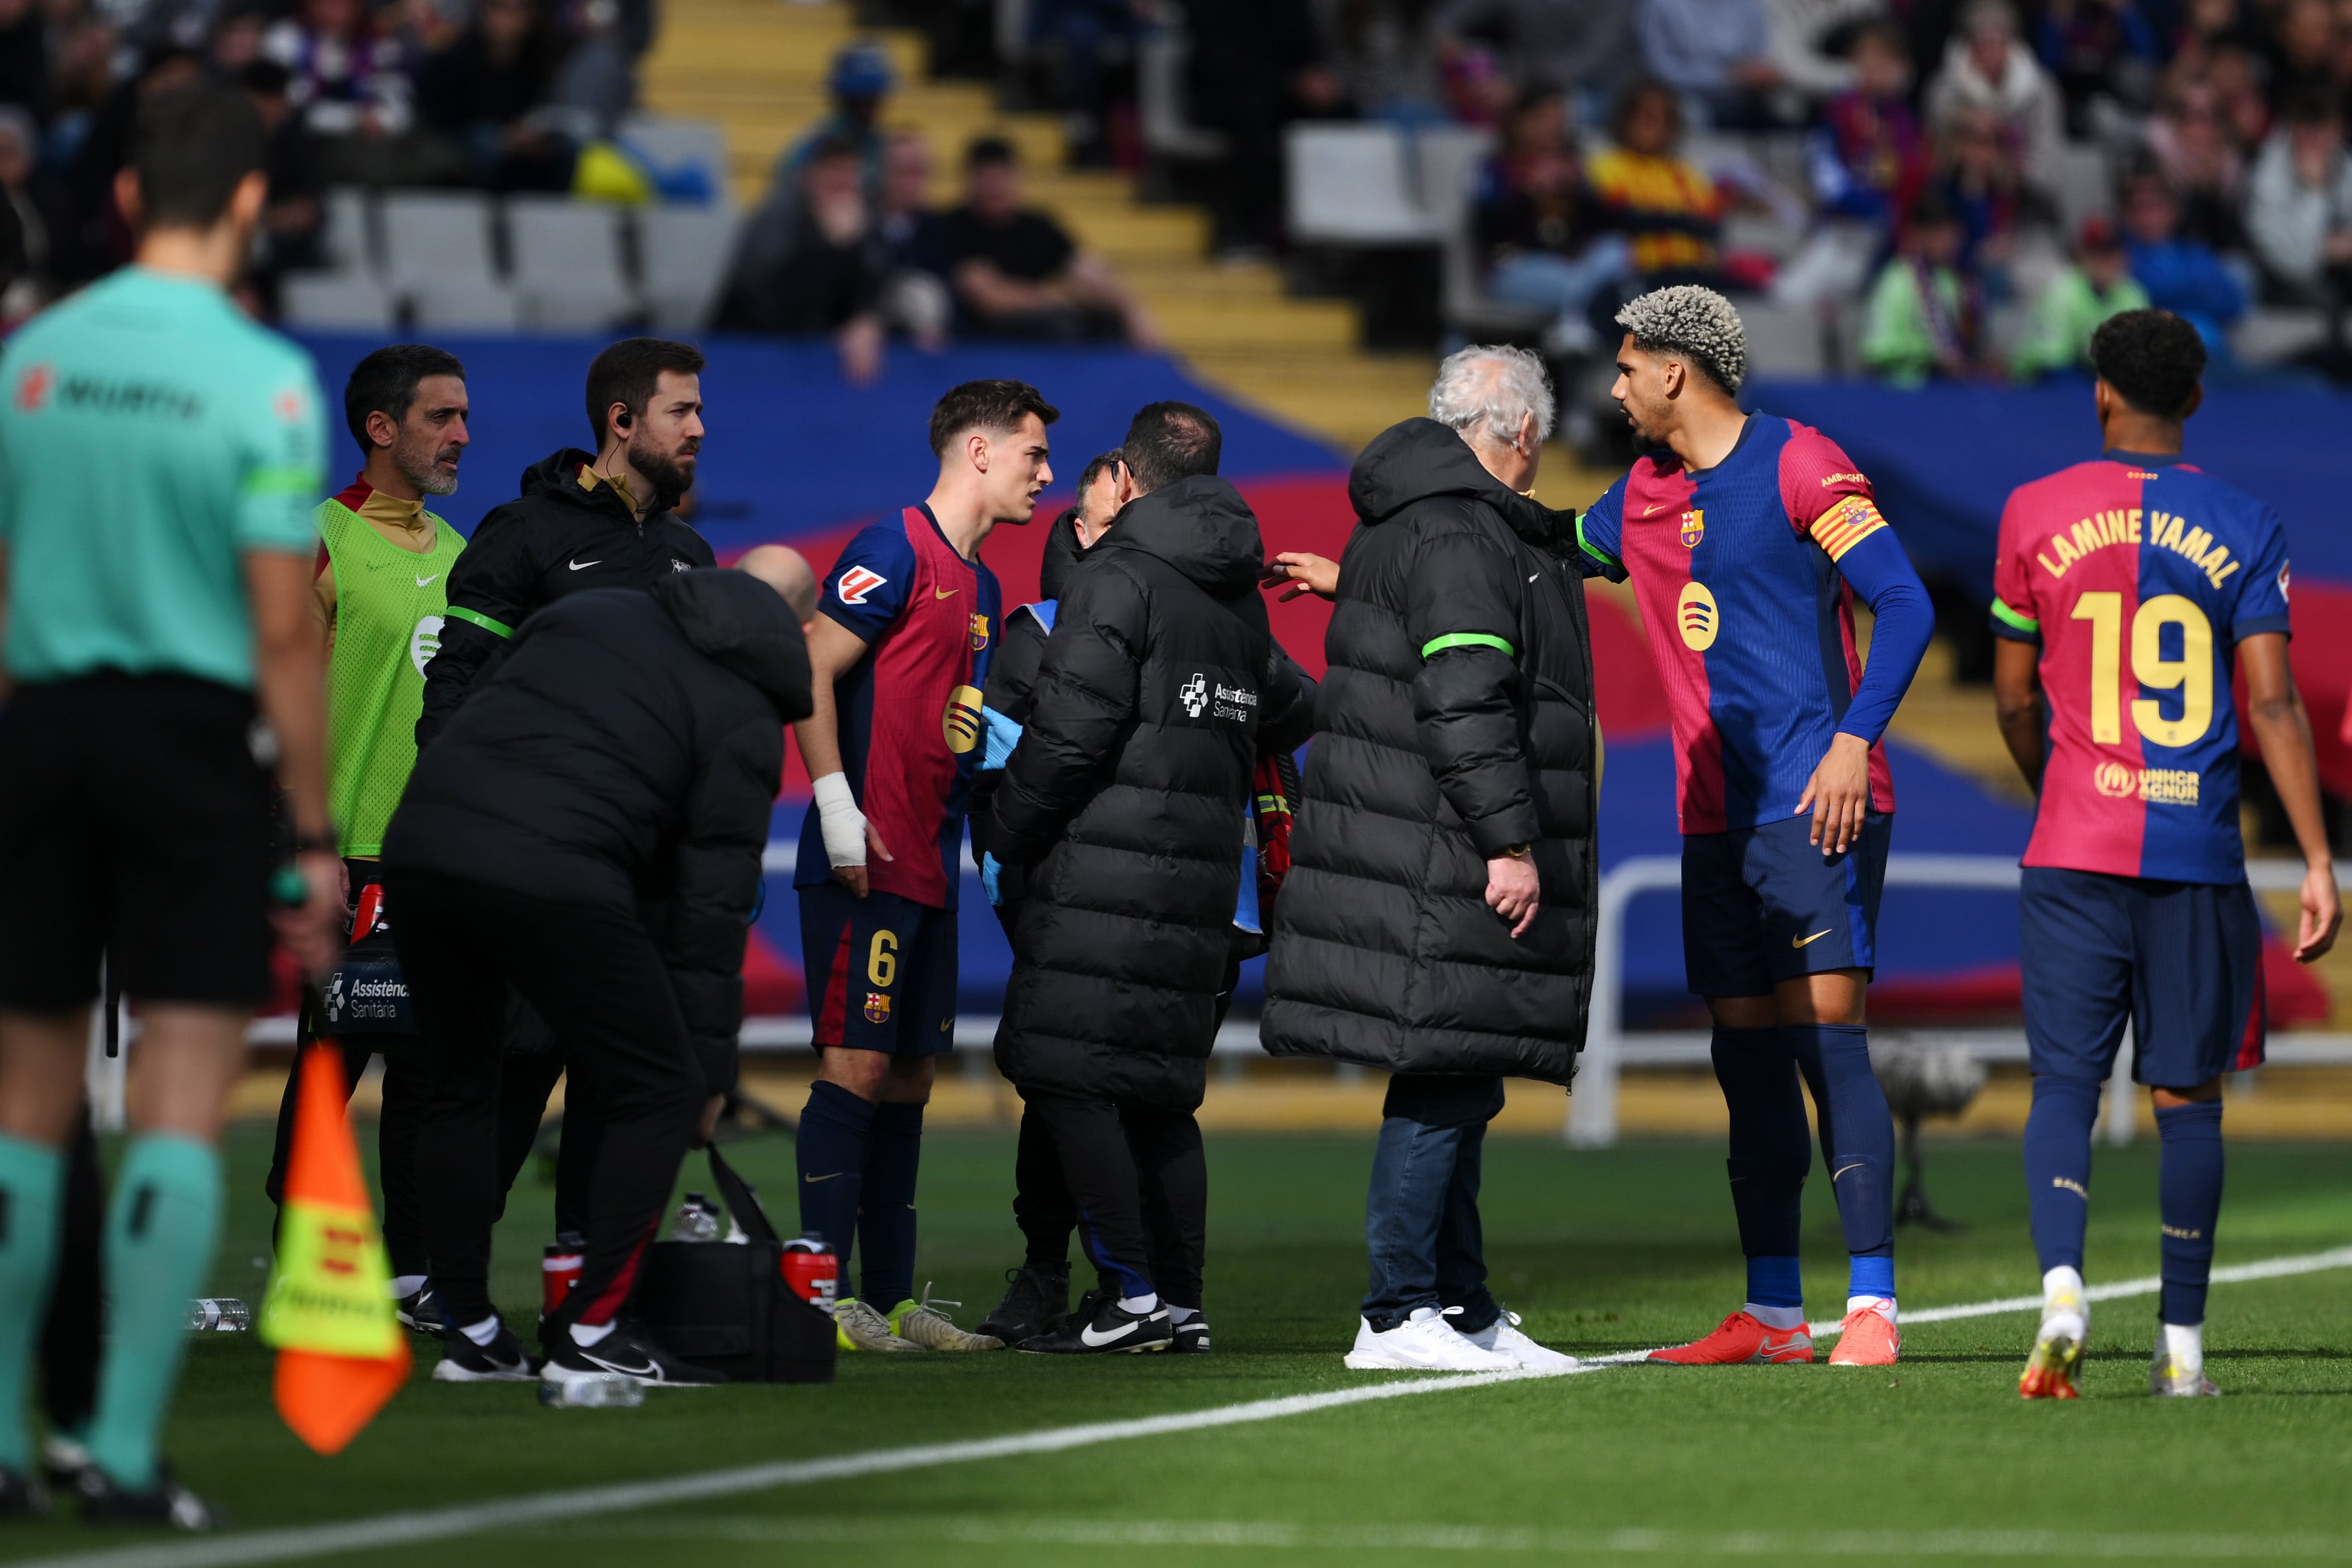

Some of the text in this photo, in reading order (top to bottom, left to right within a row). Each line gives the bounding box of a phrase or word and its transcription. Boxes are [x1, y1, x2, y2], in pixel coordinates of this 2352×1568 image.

[2037, 508, 2240, 590] LAMINE YAMAL
[2071, 591, 2213, 747] 19
[2138, 768, 2200, 786] UNHCR
[2138, 783, 2199, 800] ACNUR
[868, 929, 898, 987] 6
[351, 979, 410, 997] Assistènc
[351, 1000, 396, 1018] Sanitària
